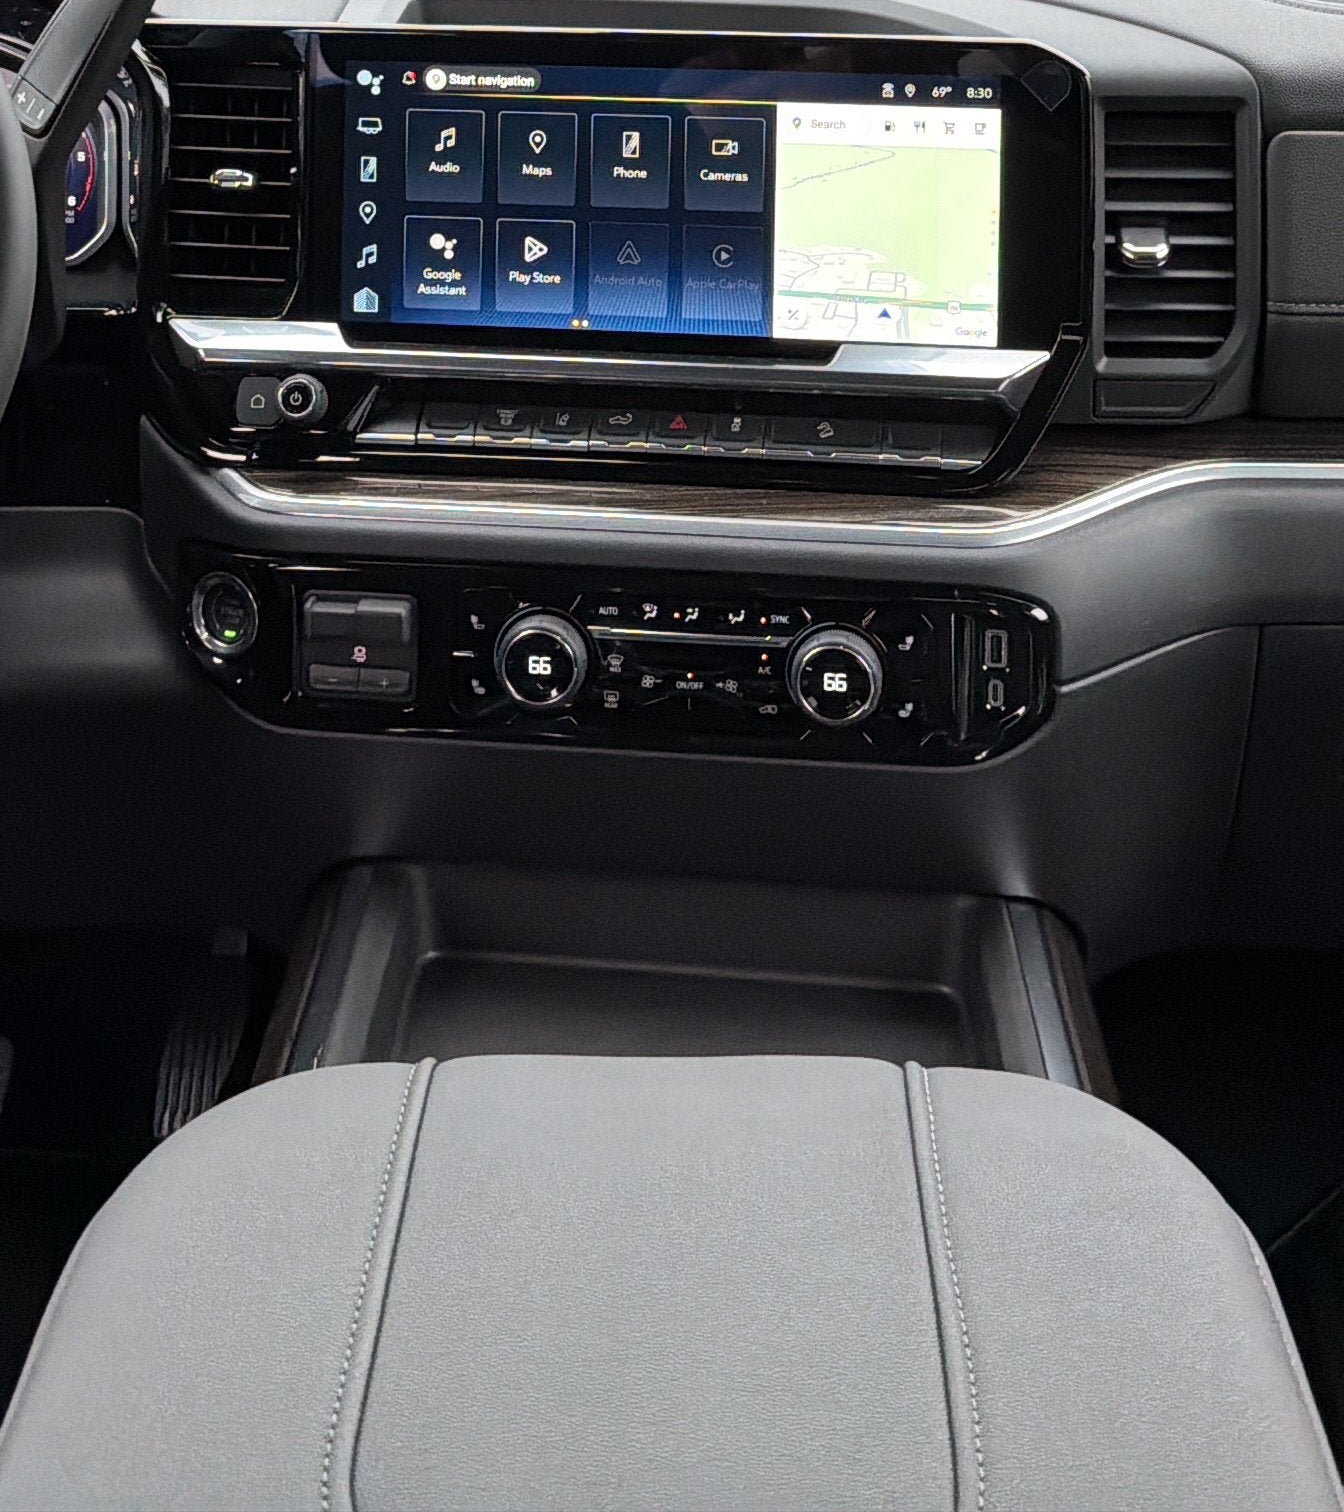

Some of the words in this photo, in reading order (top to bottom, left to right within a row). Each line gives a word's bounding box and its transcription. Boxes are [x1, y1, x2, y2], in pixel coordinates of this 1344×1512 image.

[449, 74, 475, 86] Start
[477, 74, 534, 89] navigation
[966, 87, 993, 99] 8:30
[811, 119, 846, 130] Search
[77, 151, 86, 162] 5
[429, 161, 460, 174] Audio
[522, 164, 553, 177] Maps
[613, 166, 648, 179] Phone
[700, 170, 749, 182] Cameras
[67, 195, 77, 207] 6
[423, 268, 462, 283] Google
[509, 271, 531, 285] Play
[533, 272, 561, 285] Store
[594, 274, 635, 286] Android
[636, 277, 663, 287] Auto
[417, 283, 467, 296] Assistant
[687, 278, 717, 291] Apple
[719, 278, 760, 292] CarPlay
[955, 326, 988, 339] Google
[598, 607, 619, 615] AUTO
[770, 615, 790, 624] SYNC
[528, 656, 552, 674] 66
[757, 666, 772, 675] A/C
[675, 681, 704, 690] ON/OFF
[823, 673, 847, 691] 66
